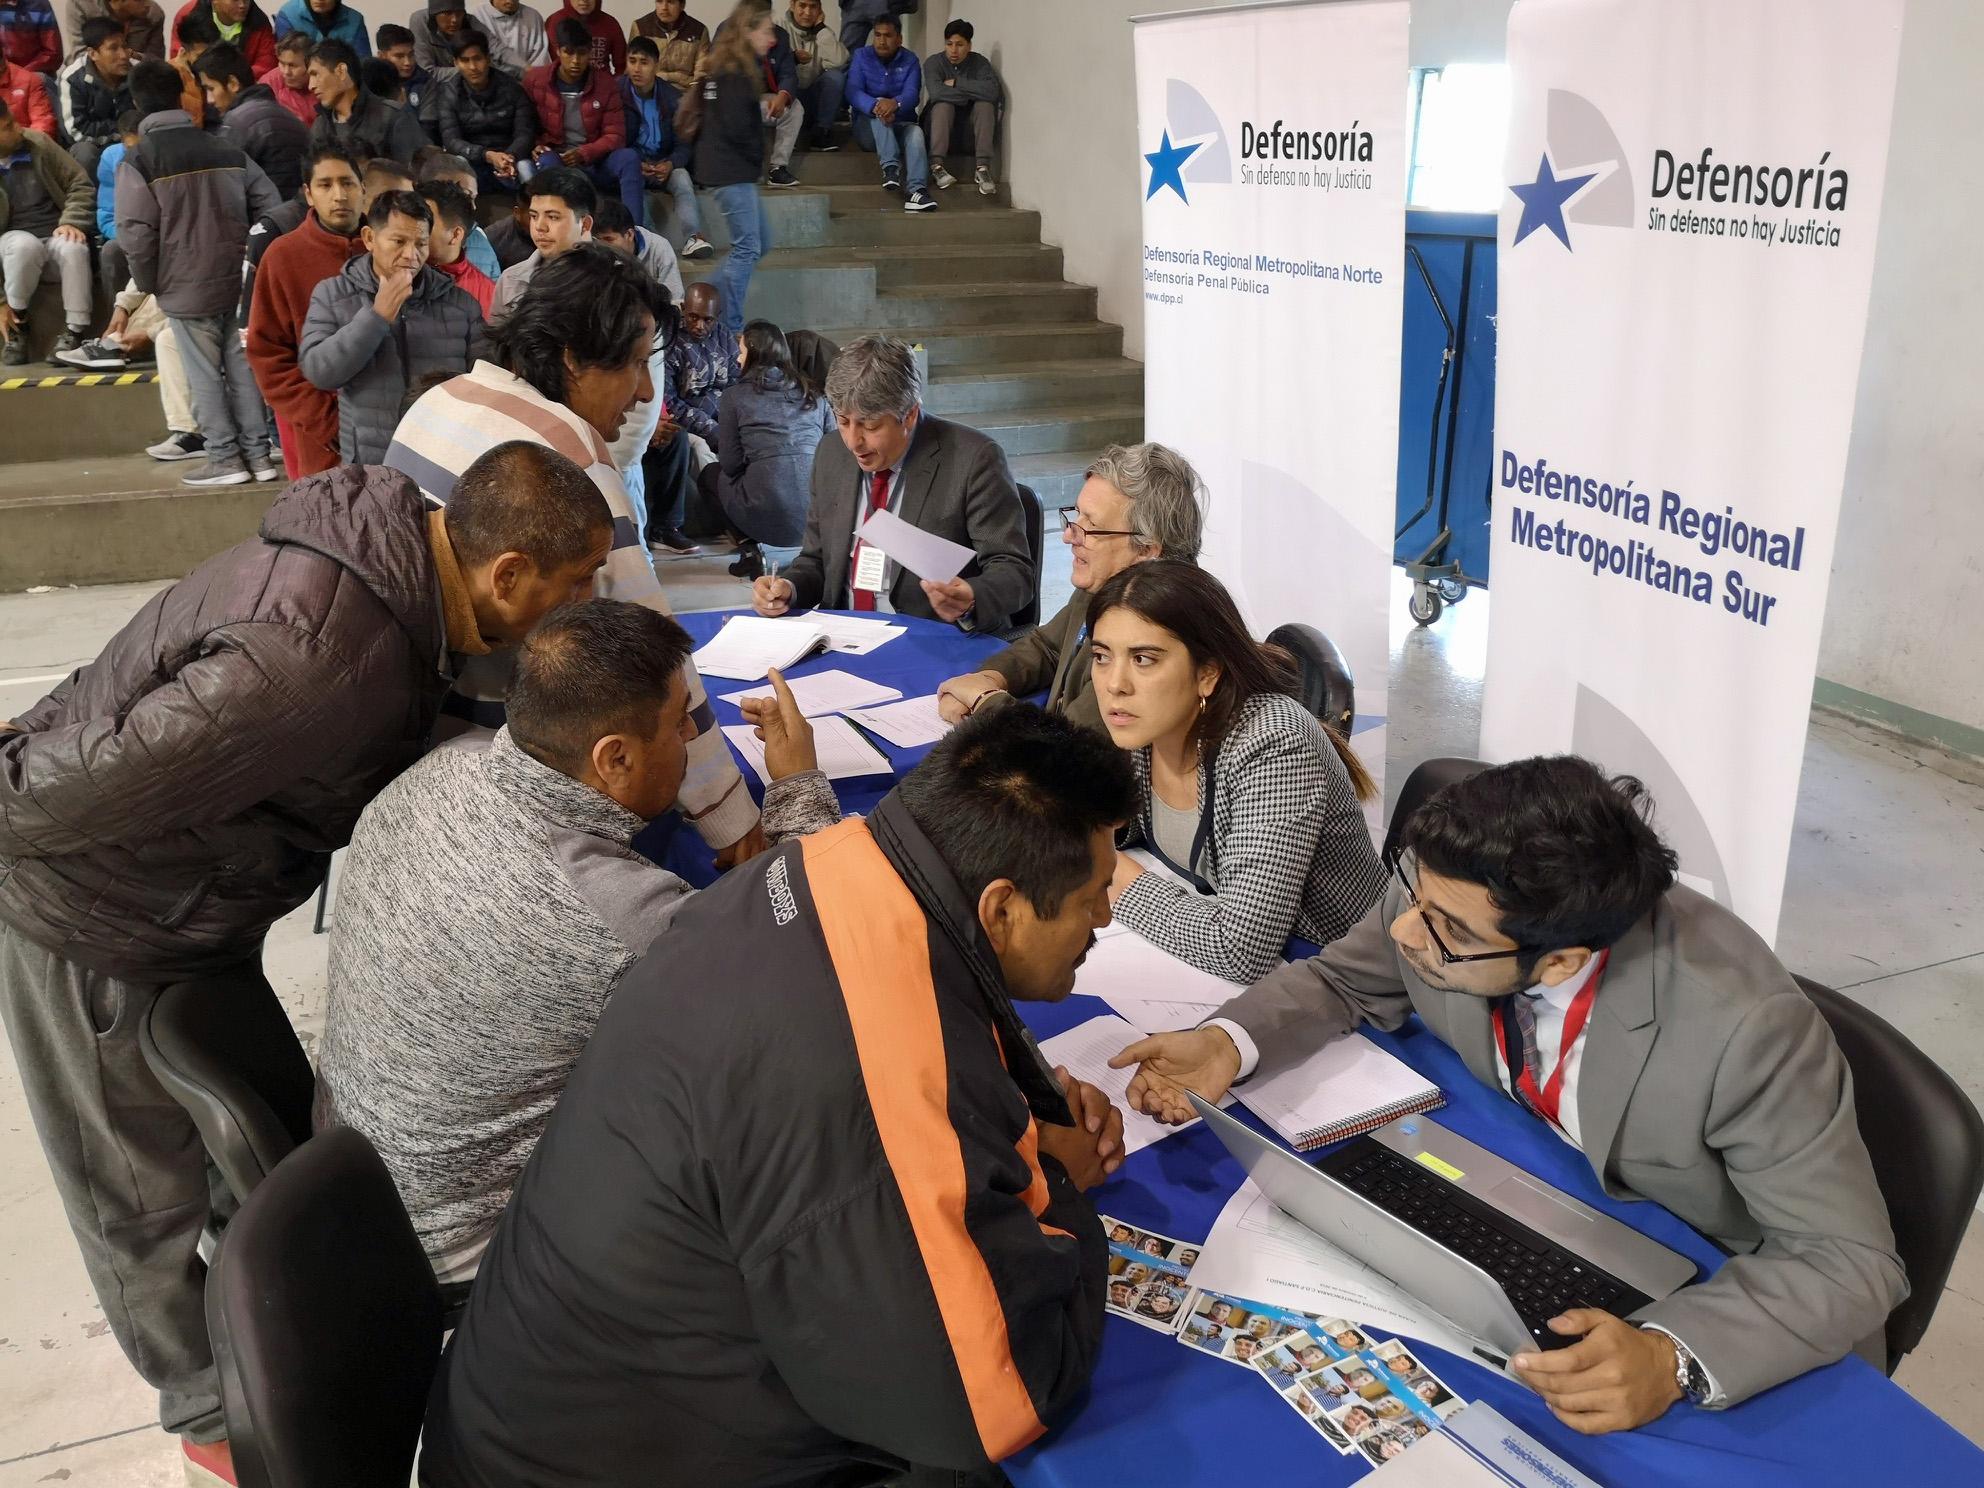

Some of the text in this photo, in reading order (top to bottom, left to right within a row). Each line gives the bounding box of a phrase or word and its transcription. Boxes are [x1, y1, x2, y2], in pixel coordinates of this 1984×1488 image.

[1241, 120, 1374, 162] Defensoría
[1240, 164, 1372, 193] Sin defensa no hay Justicia
[1651, 147, 1849, 211] Defensoría
[1648, 206, 1841, 247] Sin defensa no hay Justicia
[1144, 245, 1383, 284] Defensoría Regional Metropolitana Norte
[1144, 268, 1270, 295] Defensoría Penal Pública
[1145, 292, 1183, 305] www.dpp.cl
[1501, 449, 1806, 571] Defensoría Regional
[1511, 506, 1777, 626] Metropolitana Sur
